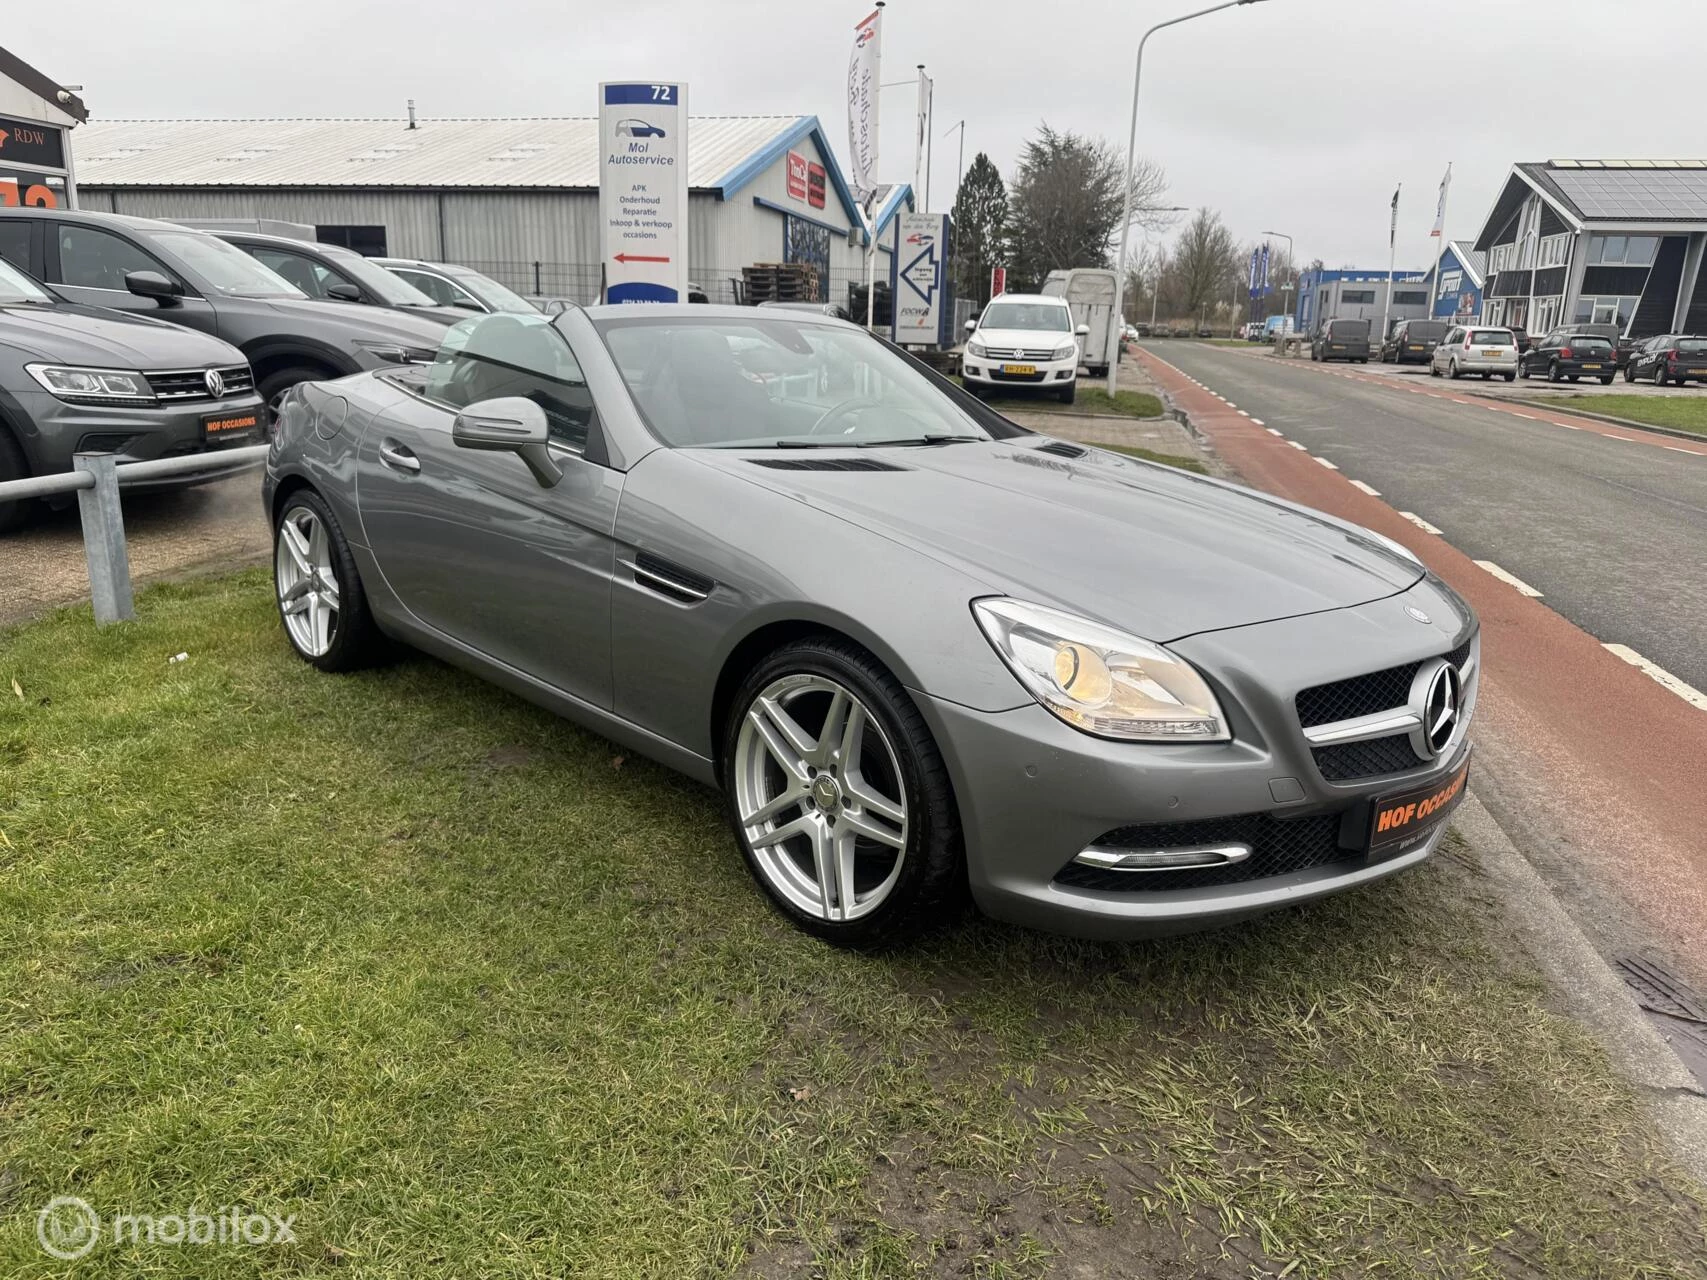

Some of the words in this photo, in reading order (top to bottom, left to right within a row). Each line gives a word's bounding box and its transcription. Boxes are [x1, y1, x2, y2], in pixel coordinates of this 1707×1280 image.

[651, 85, 671, 100] 72
[14, 127, 45, 145] RDW
[628, 142, 649, 153] Mol
[608, 154, 674, 165] Autoservice
[631, 184, 647, 192] APK
[619, 196, 660, 204] Onderhoud
[622, 207, 657, 216] Reparatie
[610, 219, 633, 228] Inkoop
[634, 219, 641, 227] &
[641, 220, 673, 230] verkoop
[622, 231, 657, 240] occasions
[207, 421, 221, 432] HOF
[222, 416, 256, 430] OCCASIONS
[1377, 803, 1416, 833] HOF
[1416, 767, 1467, 820] OCCAS
